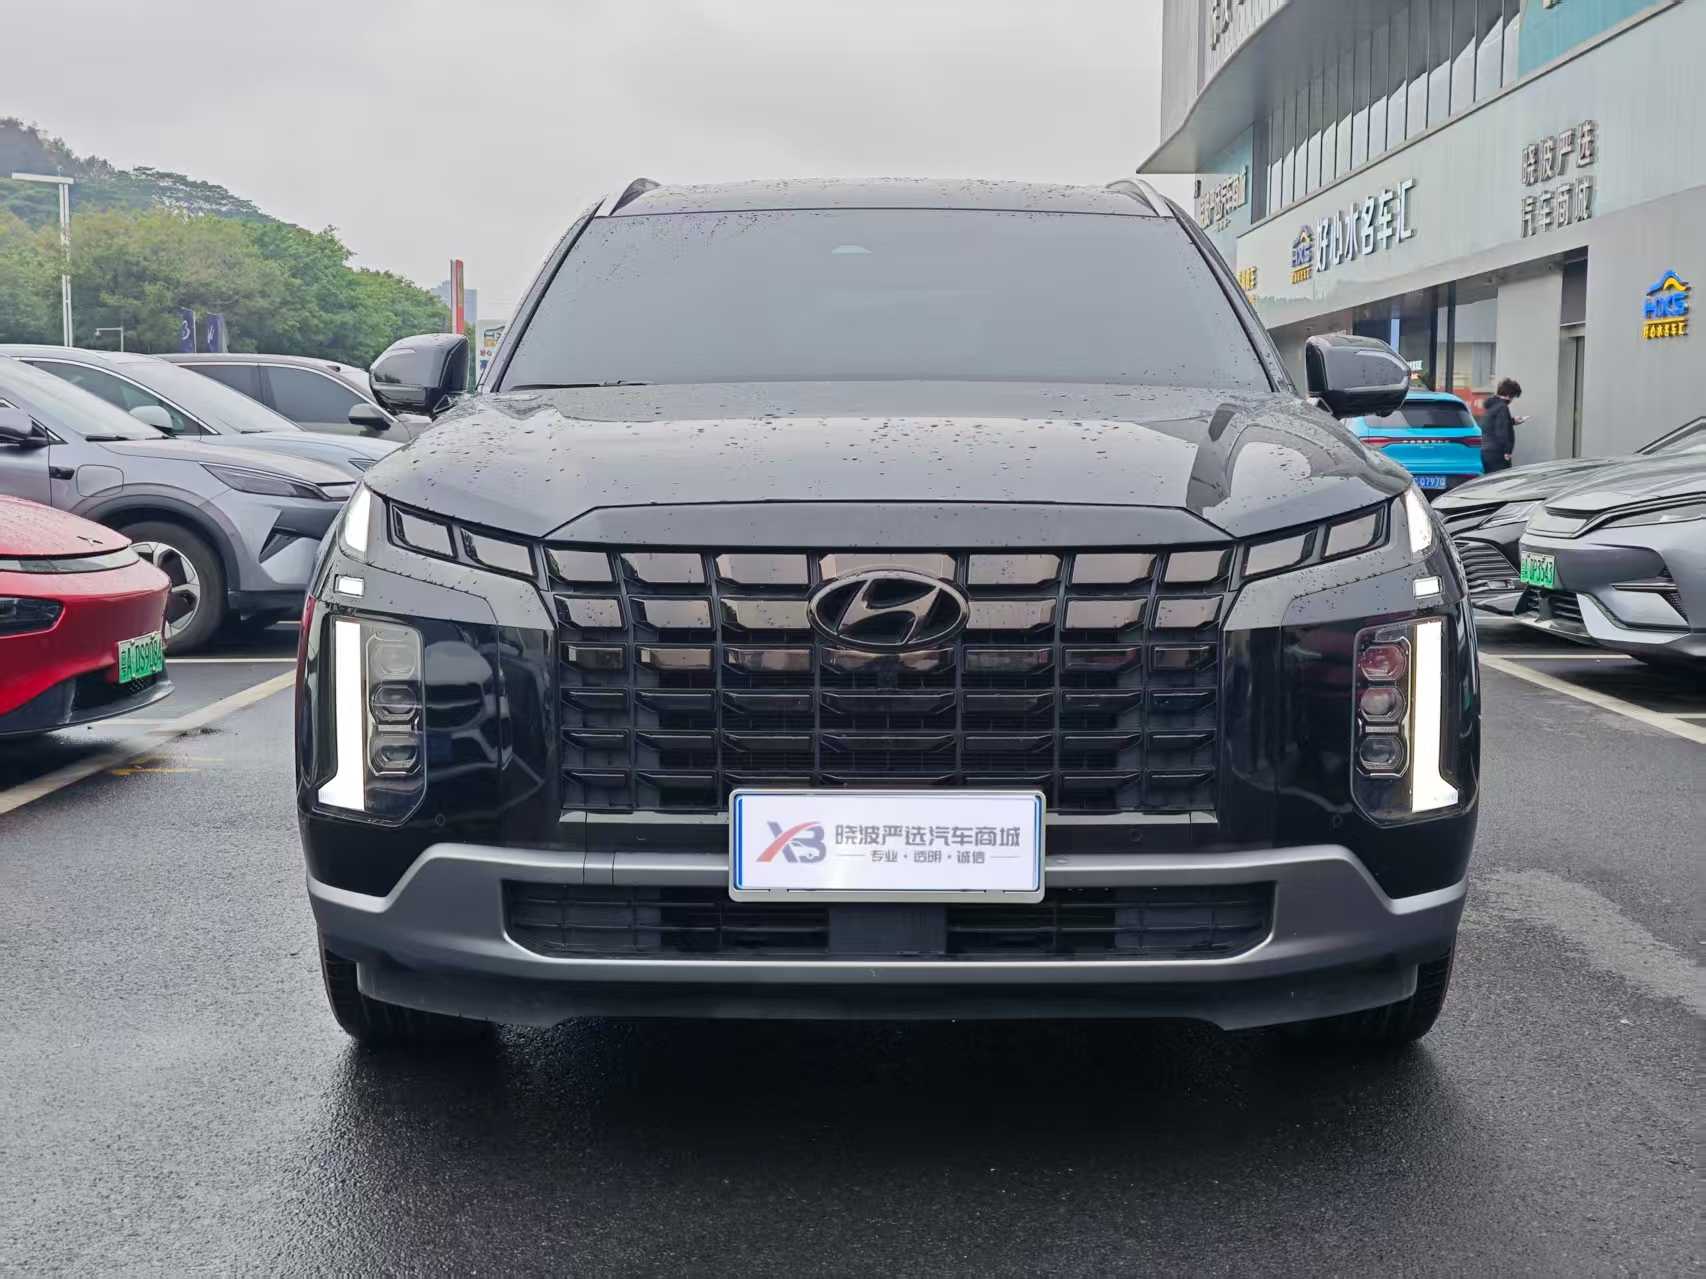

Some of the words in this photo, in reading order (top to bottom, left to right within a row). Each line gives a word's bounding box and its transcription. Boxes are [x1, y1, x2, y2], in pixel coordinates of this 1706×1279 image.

[1315, 177, 1415, 272] 好心水名车汇
[834, 824, 1021, 848] 晓波严选汽车商城
